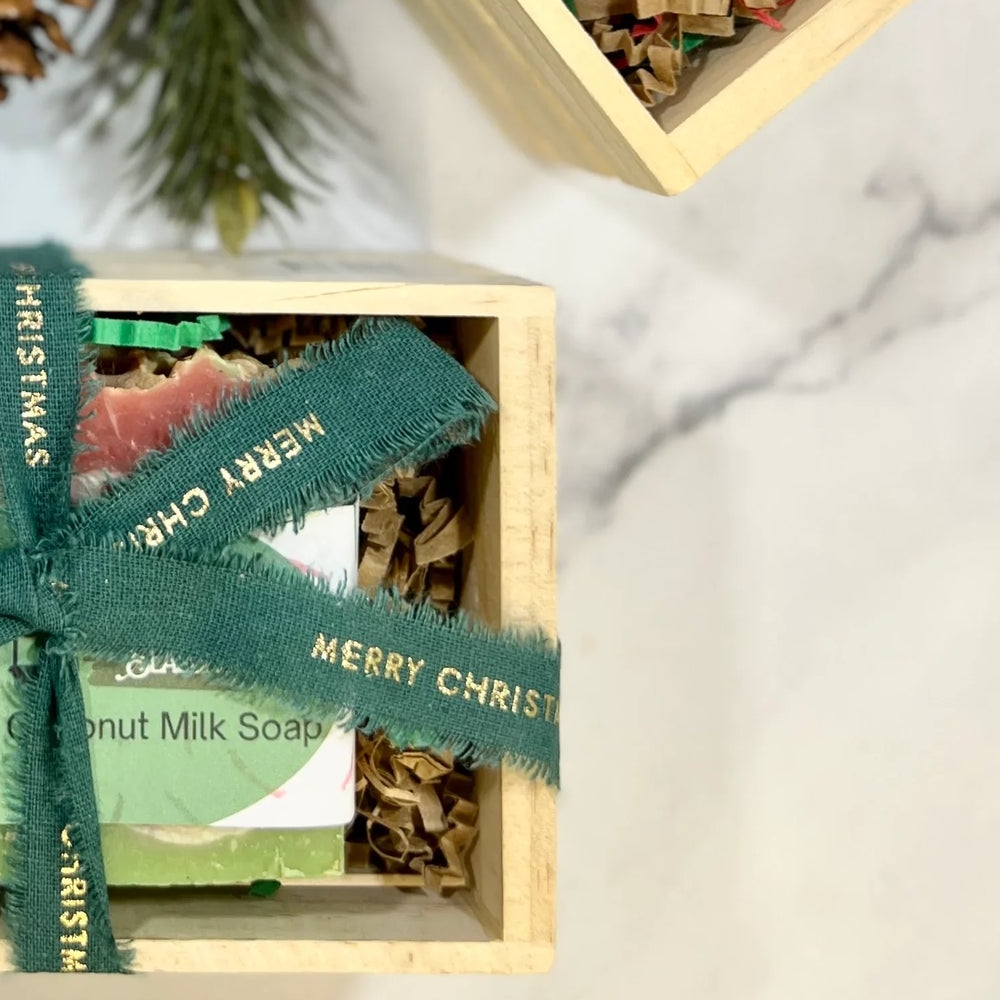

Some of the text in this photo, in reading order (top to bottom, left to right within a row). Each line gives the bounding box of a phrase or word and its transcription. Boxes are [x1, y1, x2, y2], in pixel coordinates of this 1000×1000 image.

[218, 412, 326, 497] MERRY
[310, 632, 561, 726] MERRY CHRIST
[161, 710, 226, 741] Milk
[238, 711, 323, 747] Soap
